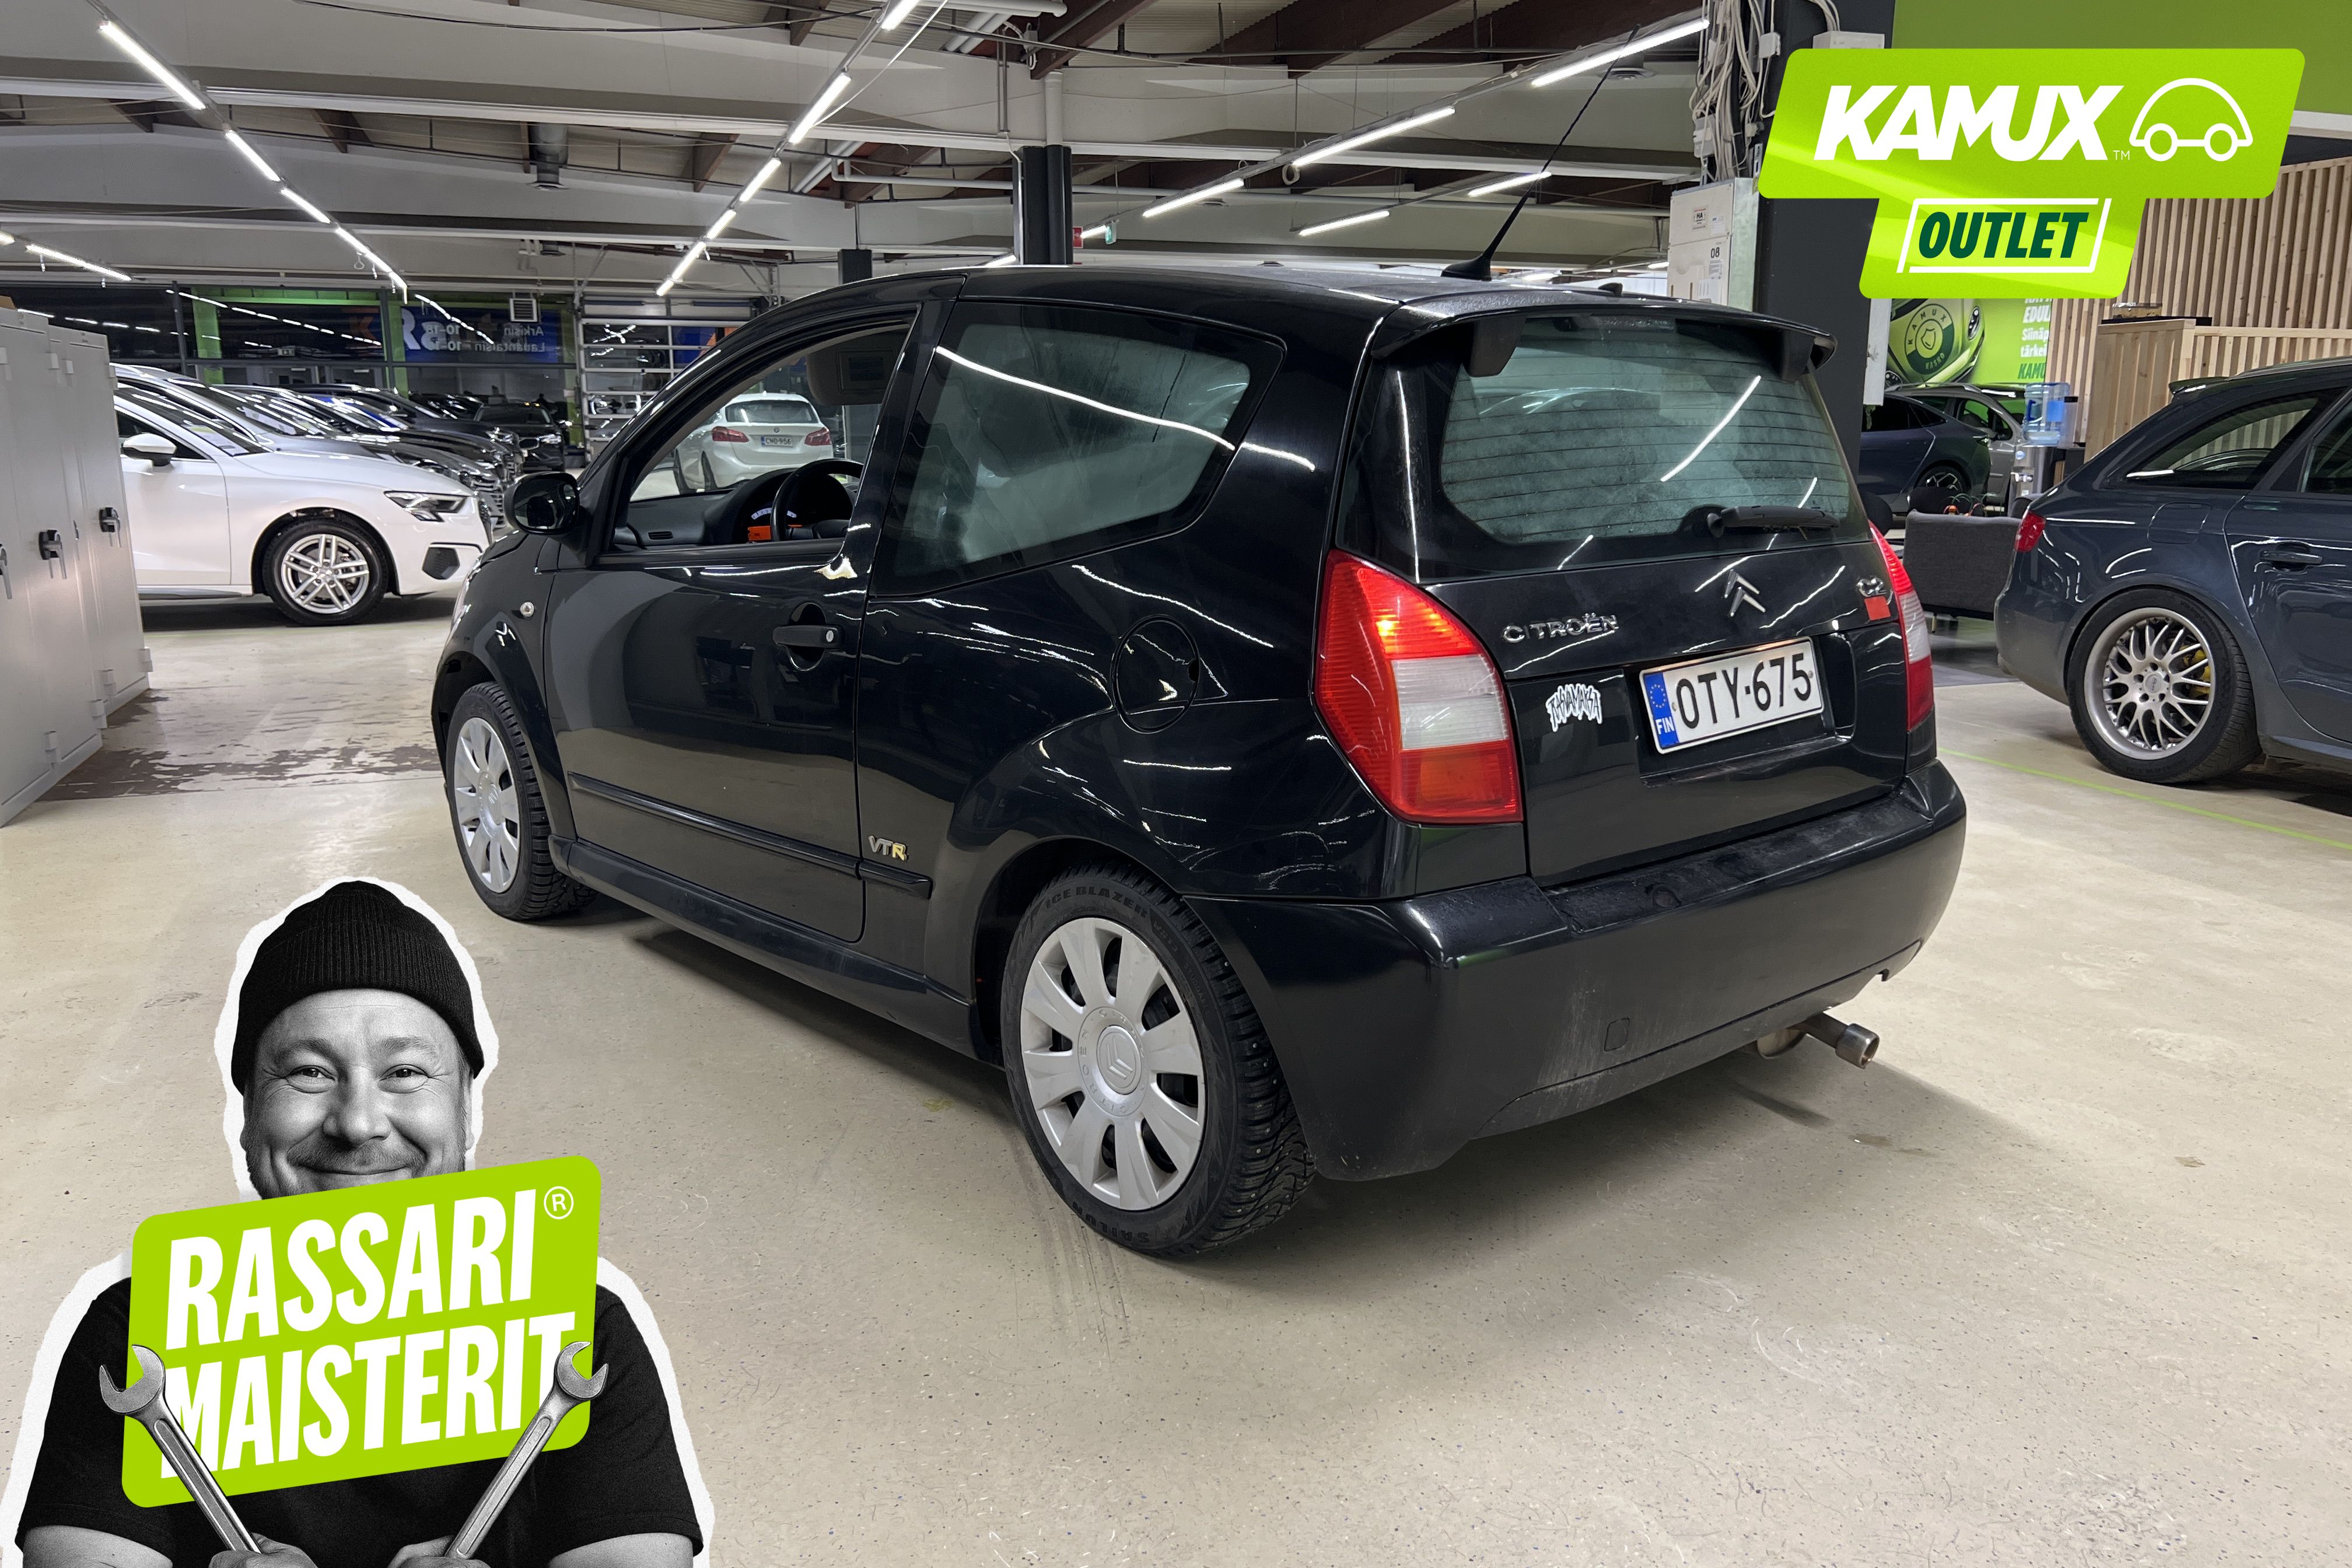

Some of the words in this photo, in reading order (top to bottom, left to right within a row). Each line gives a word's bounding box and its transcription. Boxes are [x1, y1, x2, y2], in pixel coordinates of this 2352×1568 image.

[1711, 247, 1720, 258] 08
[1908, 309, 1947, 345] KAMUX
[1926, 352, 1945, 370] KASKO
[1856, 578, 1887, 597] C2
[1502, 612, 1619, 643] CITROËN
[1676, 652, 1811, 729] OTY-675
[1655, 716, 1675, 735] FIN
[868, 835, 907, 861] VTR
[1045, 888, 1072, 909] ICE
[1076, 886, 1148, 918] BLAZER
[1072, 1201, 1150, 1243] SAILUN
